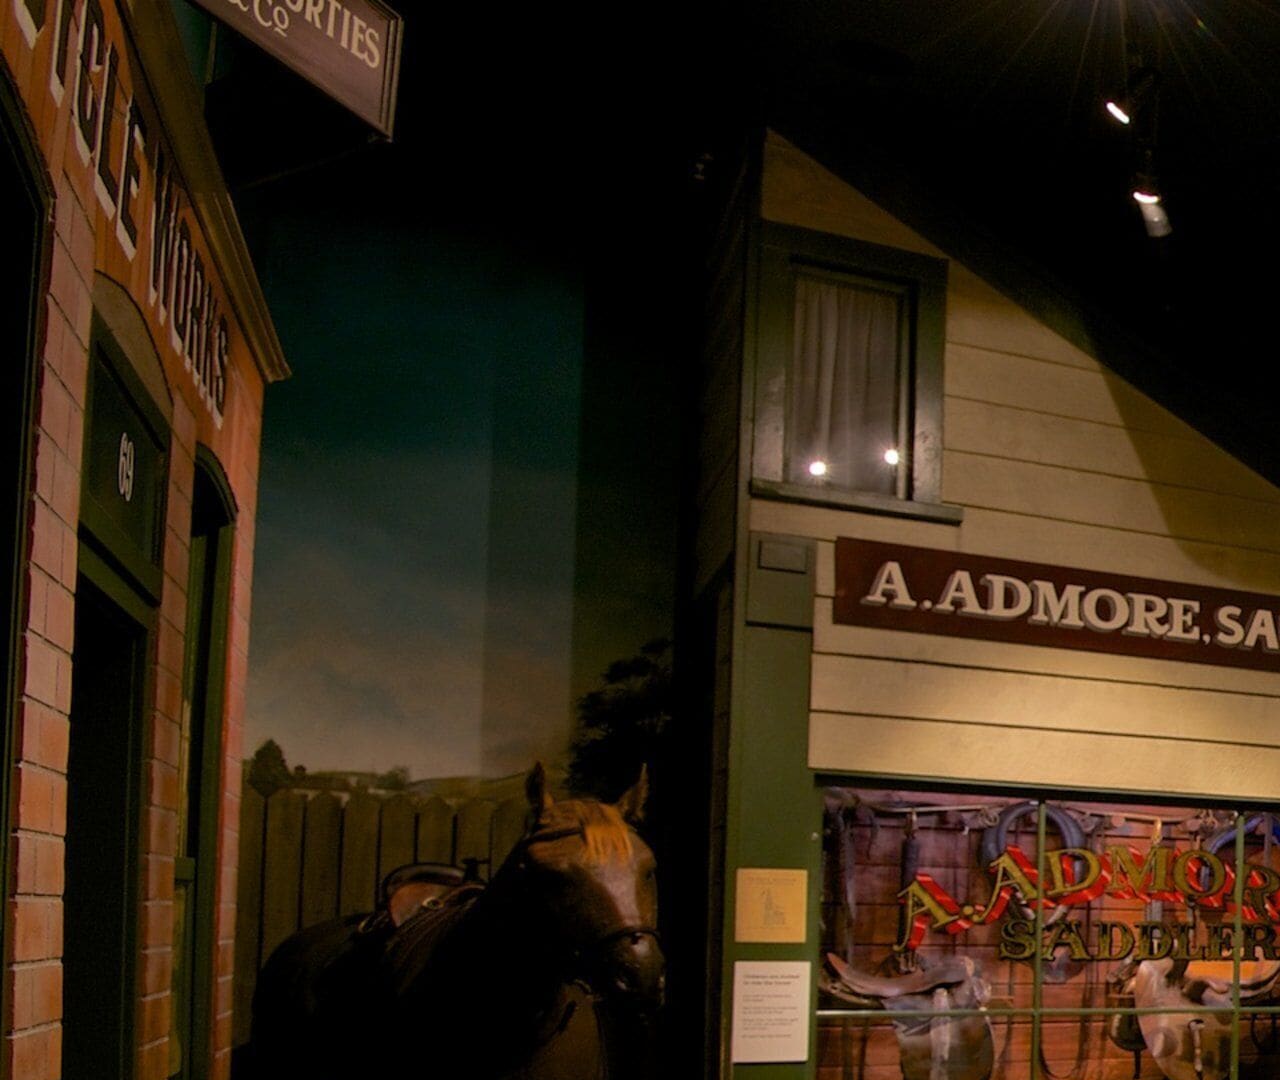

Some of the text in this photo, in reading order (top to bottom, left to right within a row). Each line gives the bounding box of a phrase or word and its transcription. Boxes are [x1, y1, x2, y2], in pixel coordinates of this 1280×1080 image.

[150, 142, 228, 430] WORKS
[118, 432, 136, 503] 69
[860, 561, 932, 610] A.
[931, 570, 1212, 645] ADMORE,
[892, 878, 973, 952] A.
